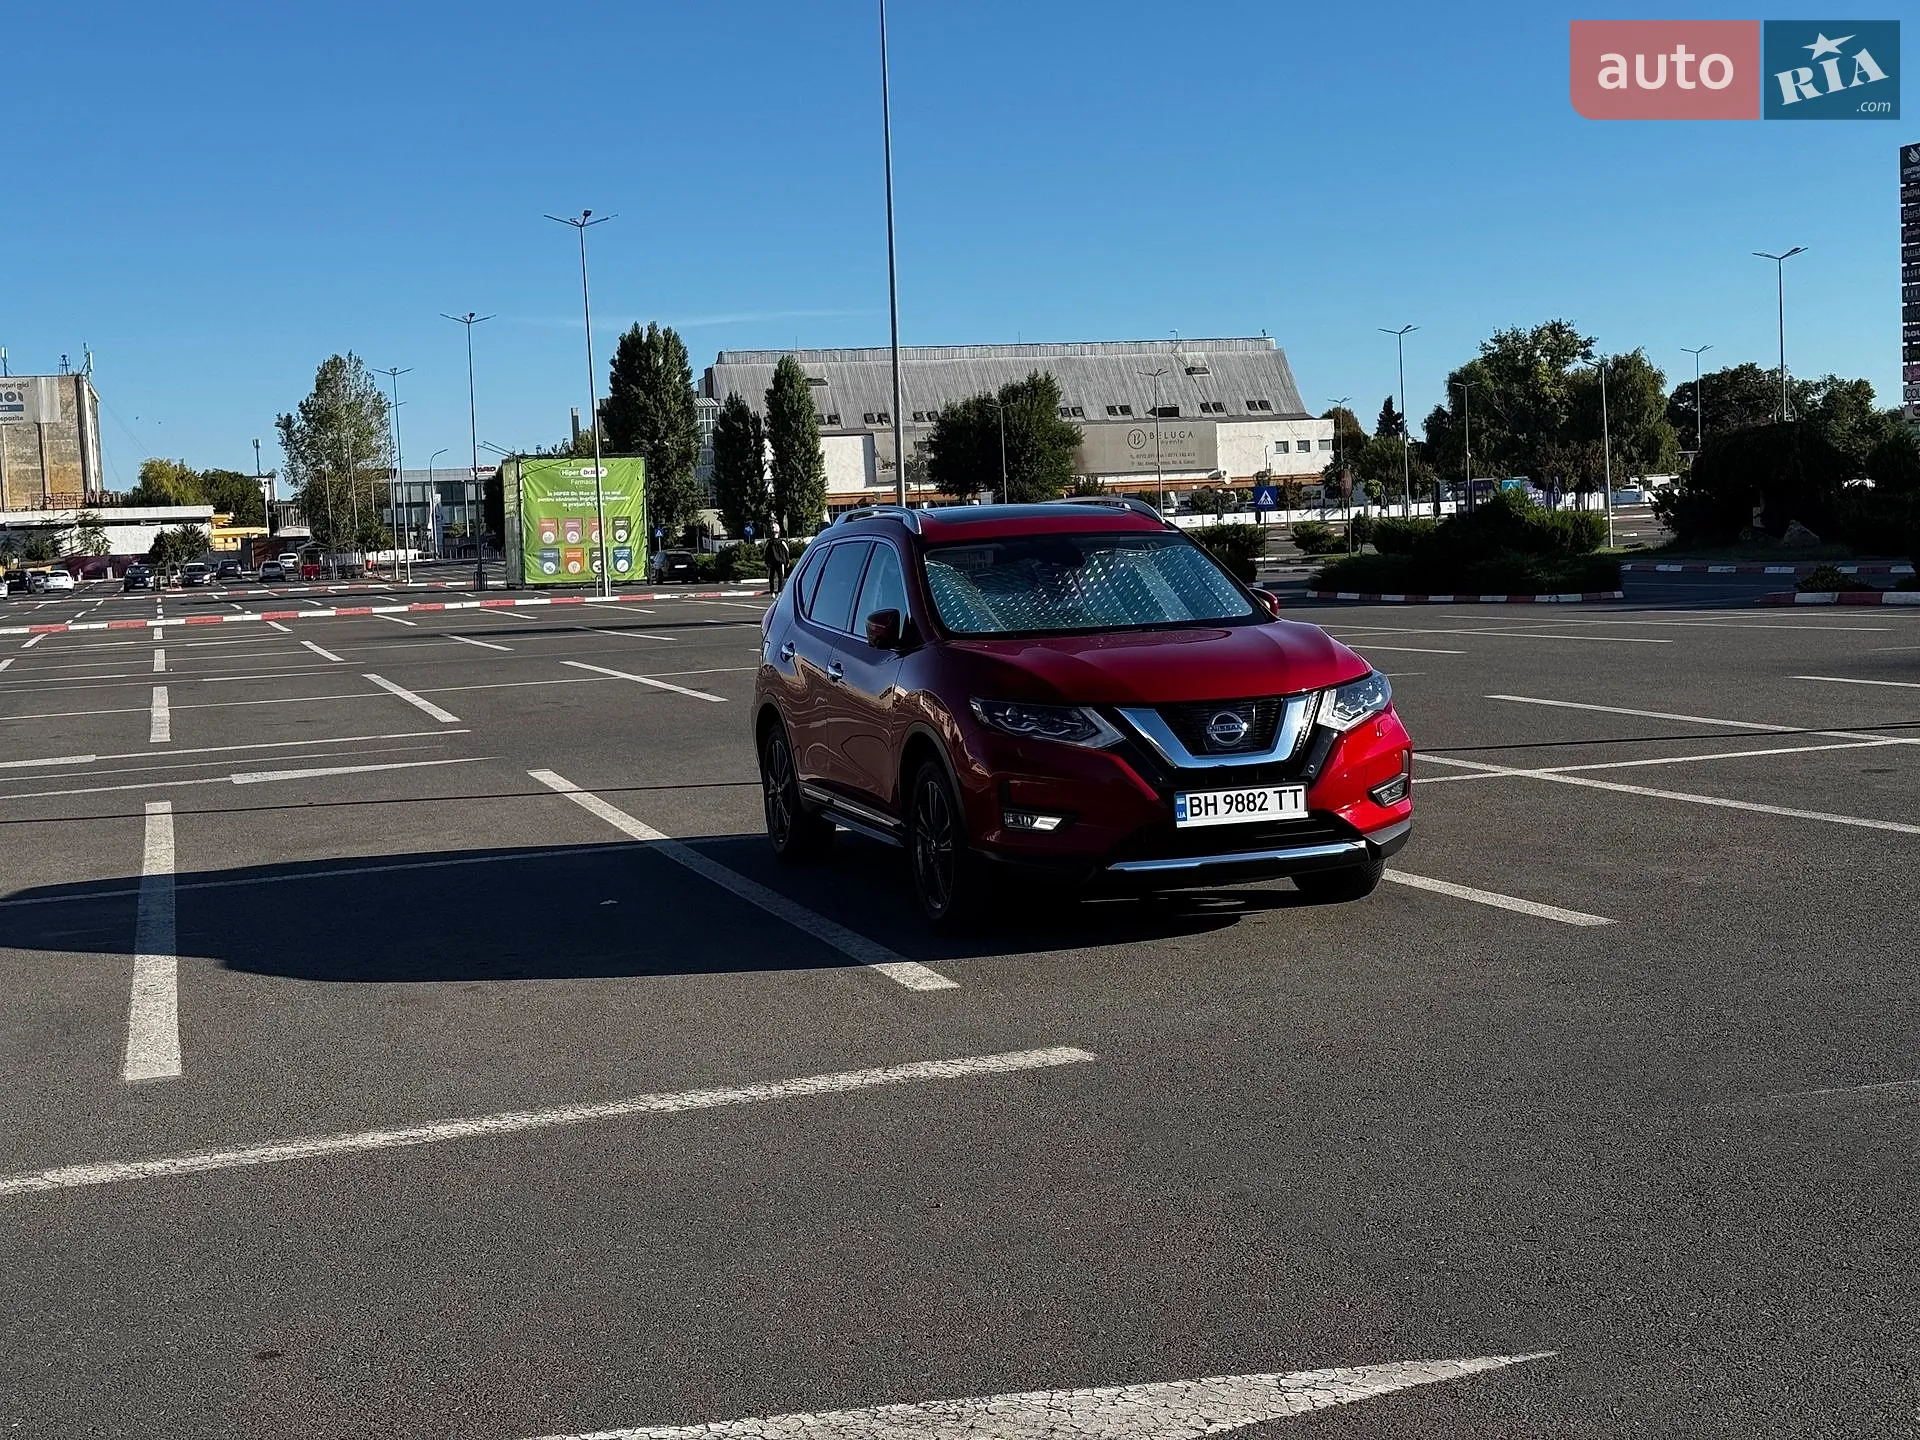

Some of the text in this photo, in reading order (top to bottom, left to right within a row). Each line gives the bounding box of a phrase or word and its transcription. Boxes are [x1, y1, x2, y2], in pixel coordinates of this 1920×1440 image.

[1149, 431, 1194, 440] BELUGA
[561, 469, 579, 477] Hiper
[1210, 724, 1243, 732] NISSAN
[1189, 788, 1303, 818] BH 9882 TT
[1176, 812, 1187, 820] UA
